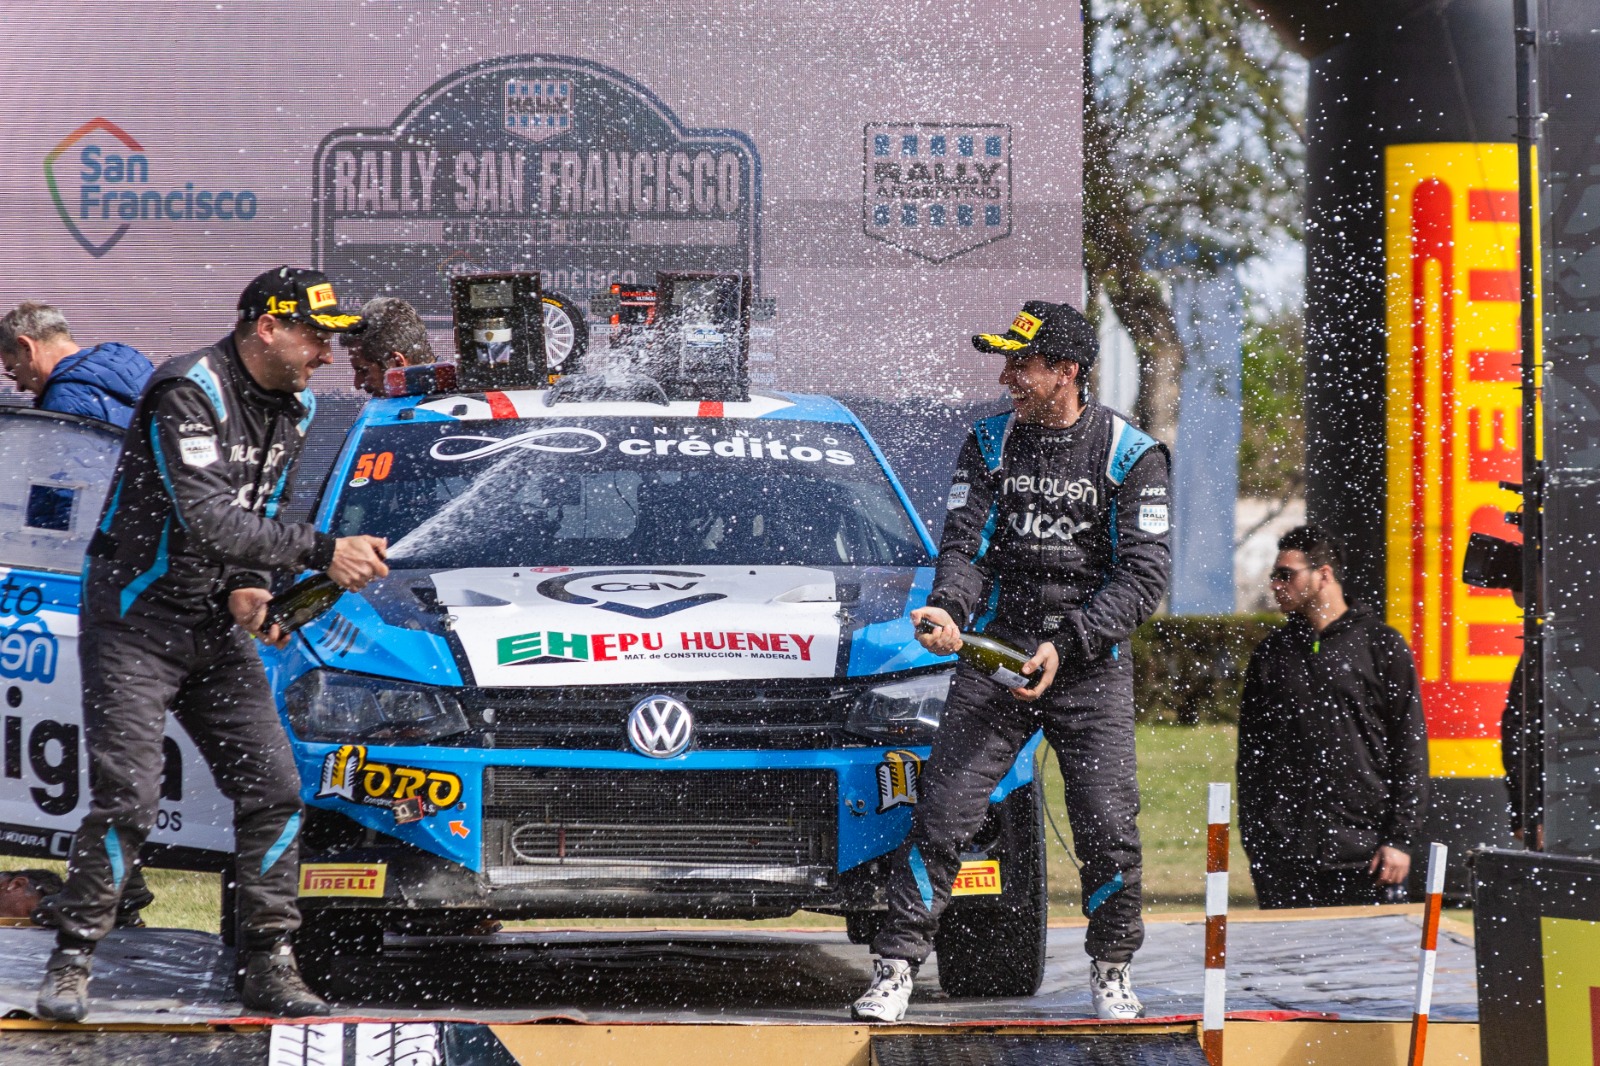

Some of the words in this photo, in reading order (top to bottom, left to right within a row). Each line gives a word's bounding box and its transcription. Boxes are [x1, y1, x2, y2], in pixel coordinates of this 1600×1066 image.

[80, 145, 148, 182] San
[874, 163, 1001, 184] RALLY
[334, 150, 437, 211] RALLY
[454, 150, 524, 211] SAN
[541, 150, 740, 211] FRANCISCO
[80, 182, 257, 220] Francisco
[618, 435, 856, 466] créditos
[630, 426, 839, 446] INFINITO
[353, 451, 394, 480] 50
[591, 632, 663, 662] EPU
[680, 631, 815, 662] HUENEY
[624, 653, 646, 661] MAT.
[664, 651, 742, 660] CONSTRUCCIÓN
[751, 652, 798, 660] MADERAS
[303, 869, 378, 890] PIRELLI
